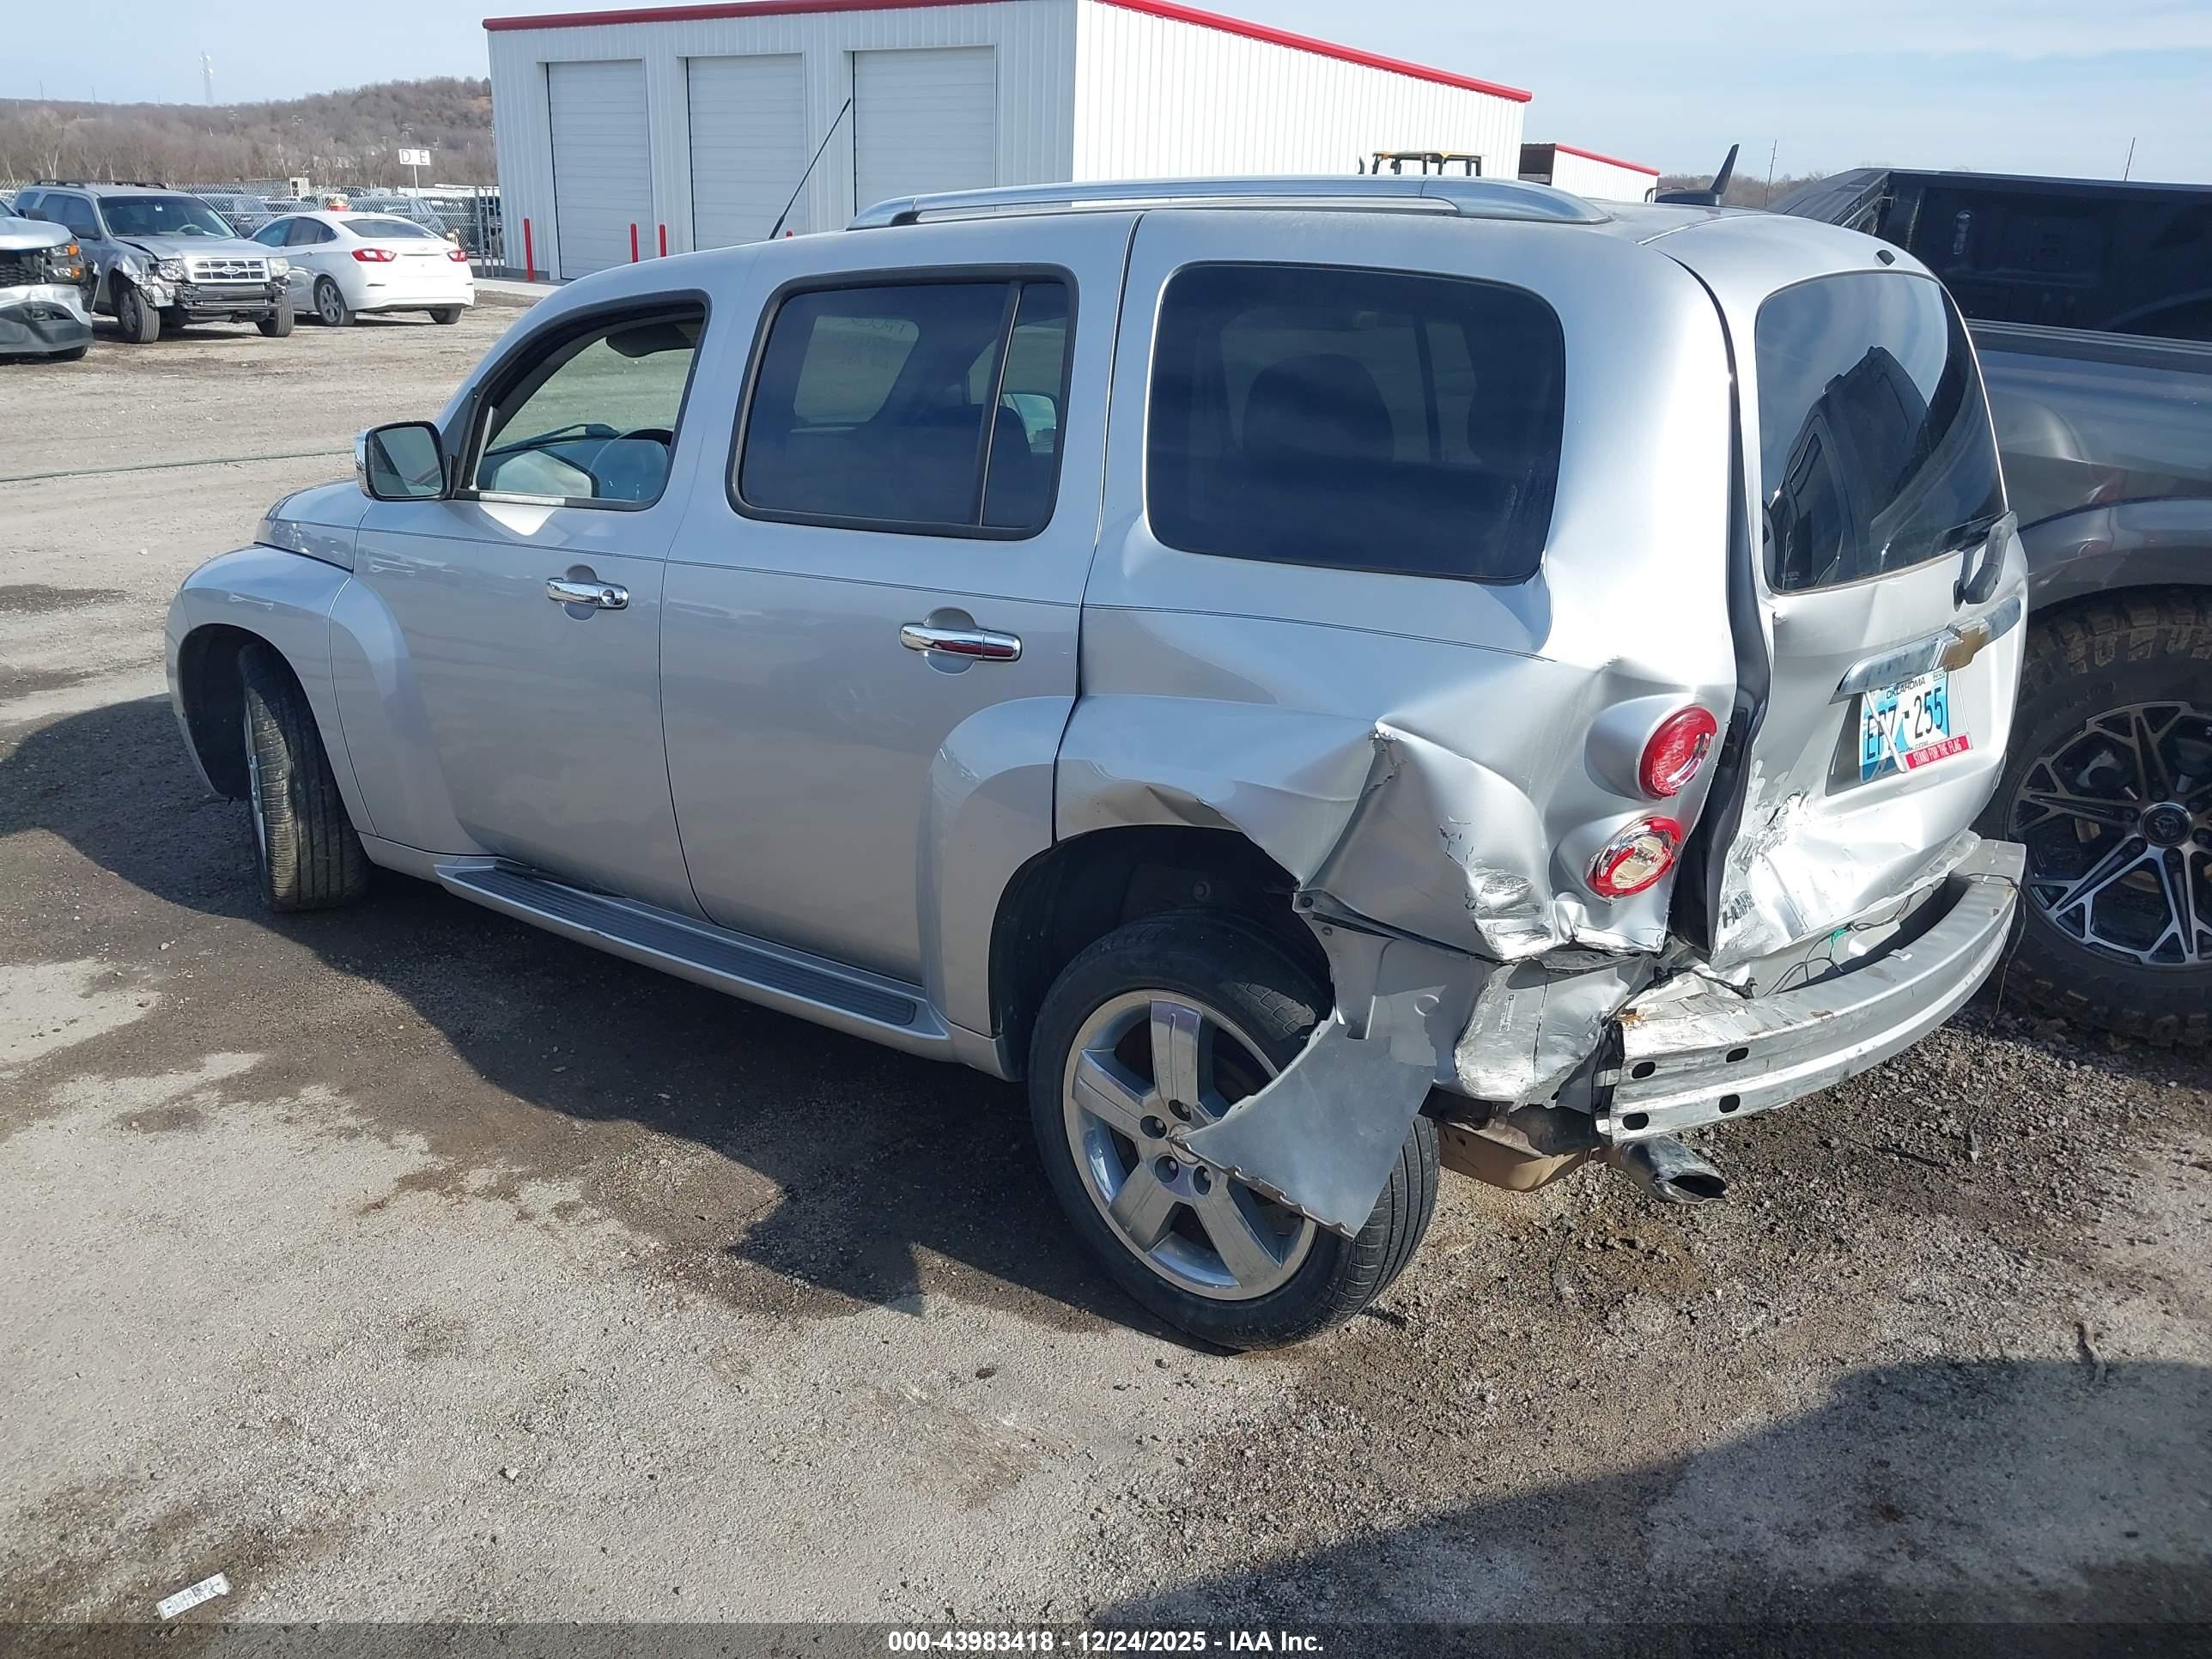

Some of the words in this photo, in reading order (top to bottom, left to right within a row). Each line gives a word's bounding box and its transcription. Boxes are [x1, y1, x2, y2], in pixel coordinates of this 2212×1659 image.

[401, 149, 411, 163] D
[419, 150, 427, 164] E
[1886, 677, 1925, 699] OKLAHOMA
[1913, 686, 1943, 739] 255
[1912, 749, 1929, 766] STAND
[1928, 746, 1940, 762] FOR
[1937, 743, 1949, 757] THE
[1948, 738, 1963, 754] FLAG
